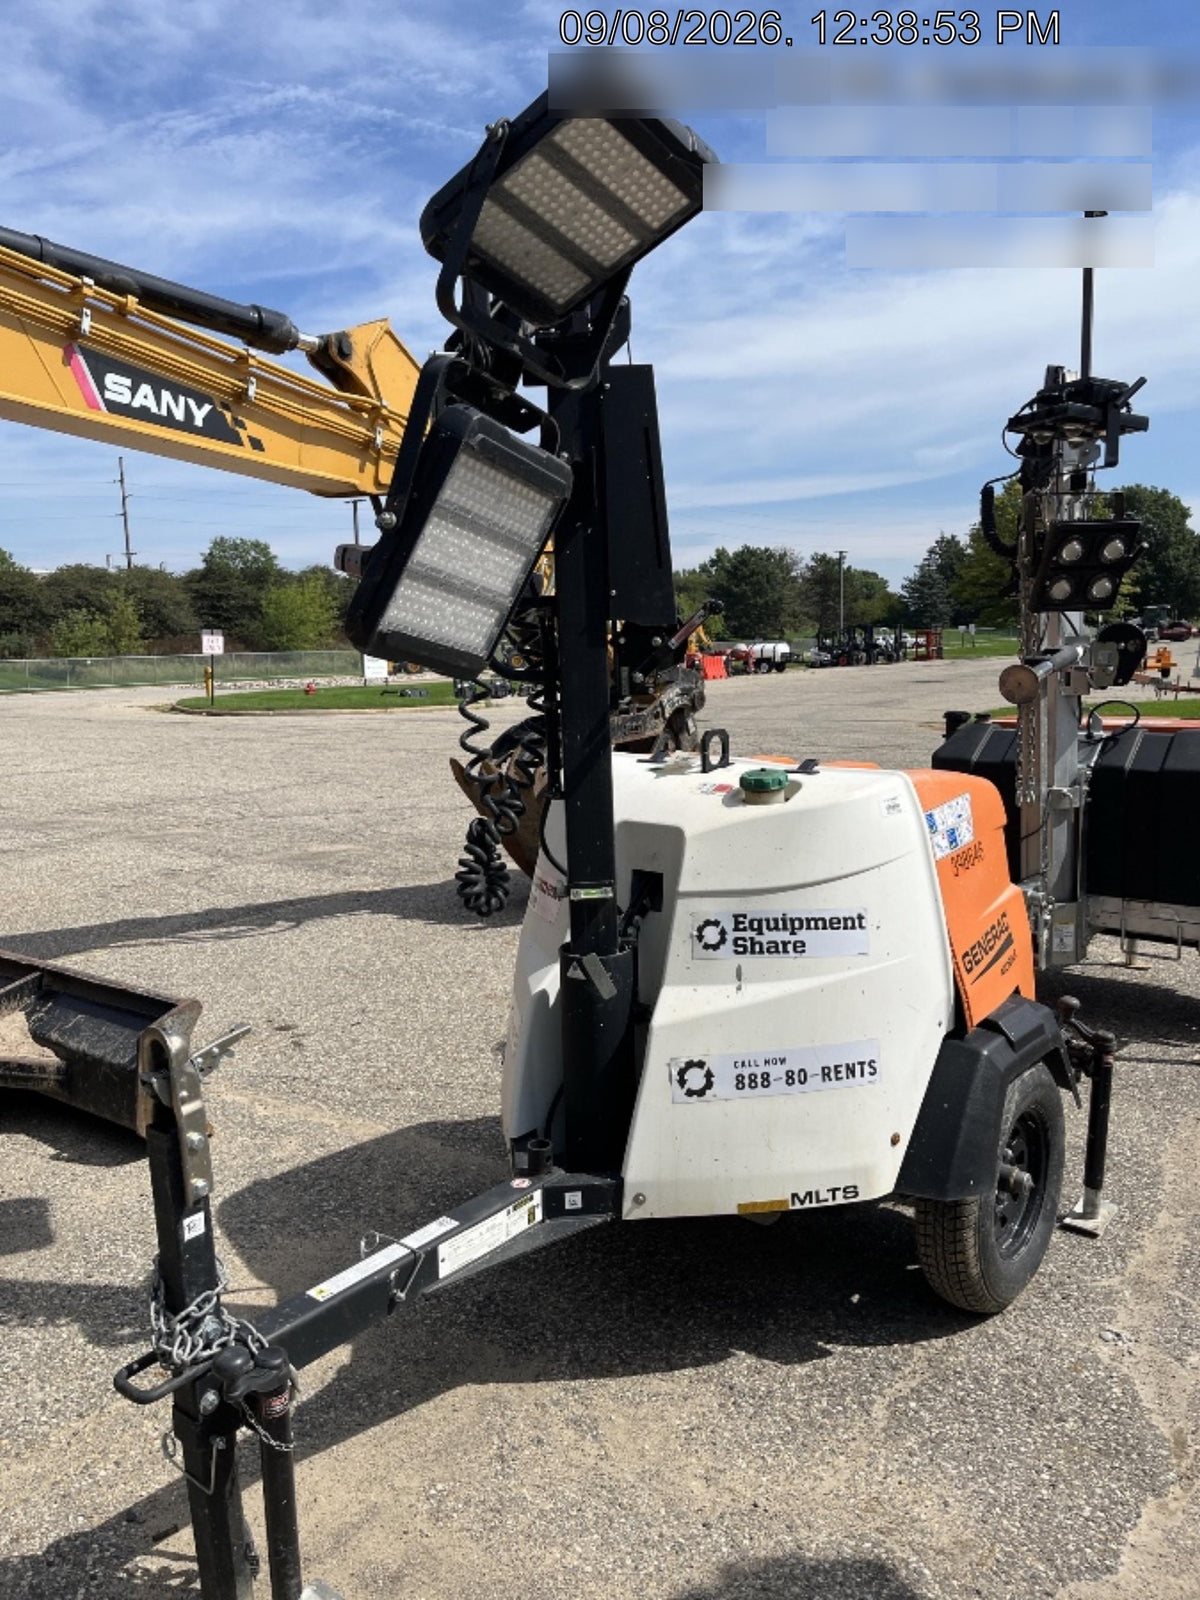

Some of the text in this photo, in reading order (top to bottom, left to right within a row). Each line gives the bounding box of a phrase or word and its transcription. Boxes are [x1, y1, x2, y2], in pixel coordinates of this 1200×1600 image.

[104, 373, 213, 427] SANY
[732, 913, 866, 936] Equipment
[732, 937, 806, 955] Share
[961, 912, 1009, 975] GENERAC
[734, 1057, 787, 1069] CALL NOW
[735, 1059, 878, 1091] 888-80-RENTS
[791, 1185, 860, 1207] MLTS
